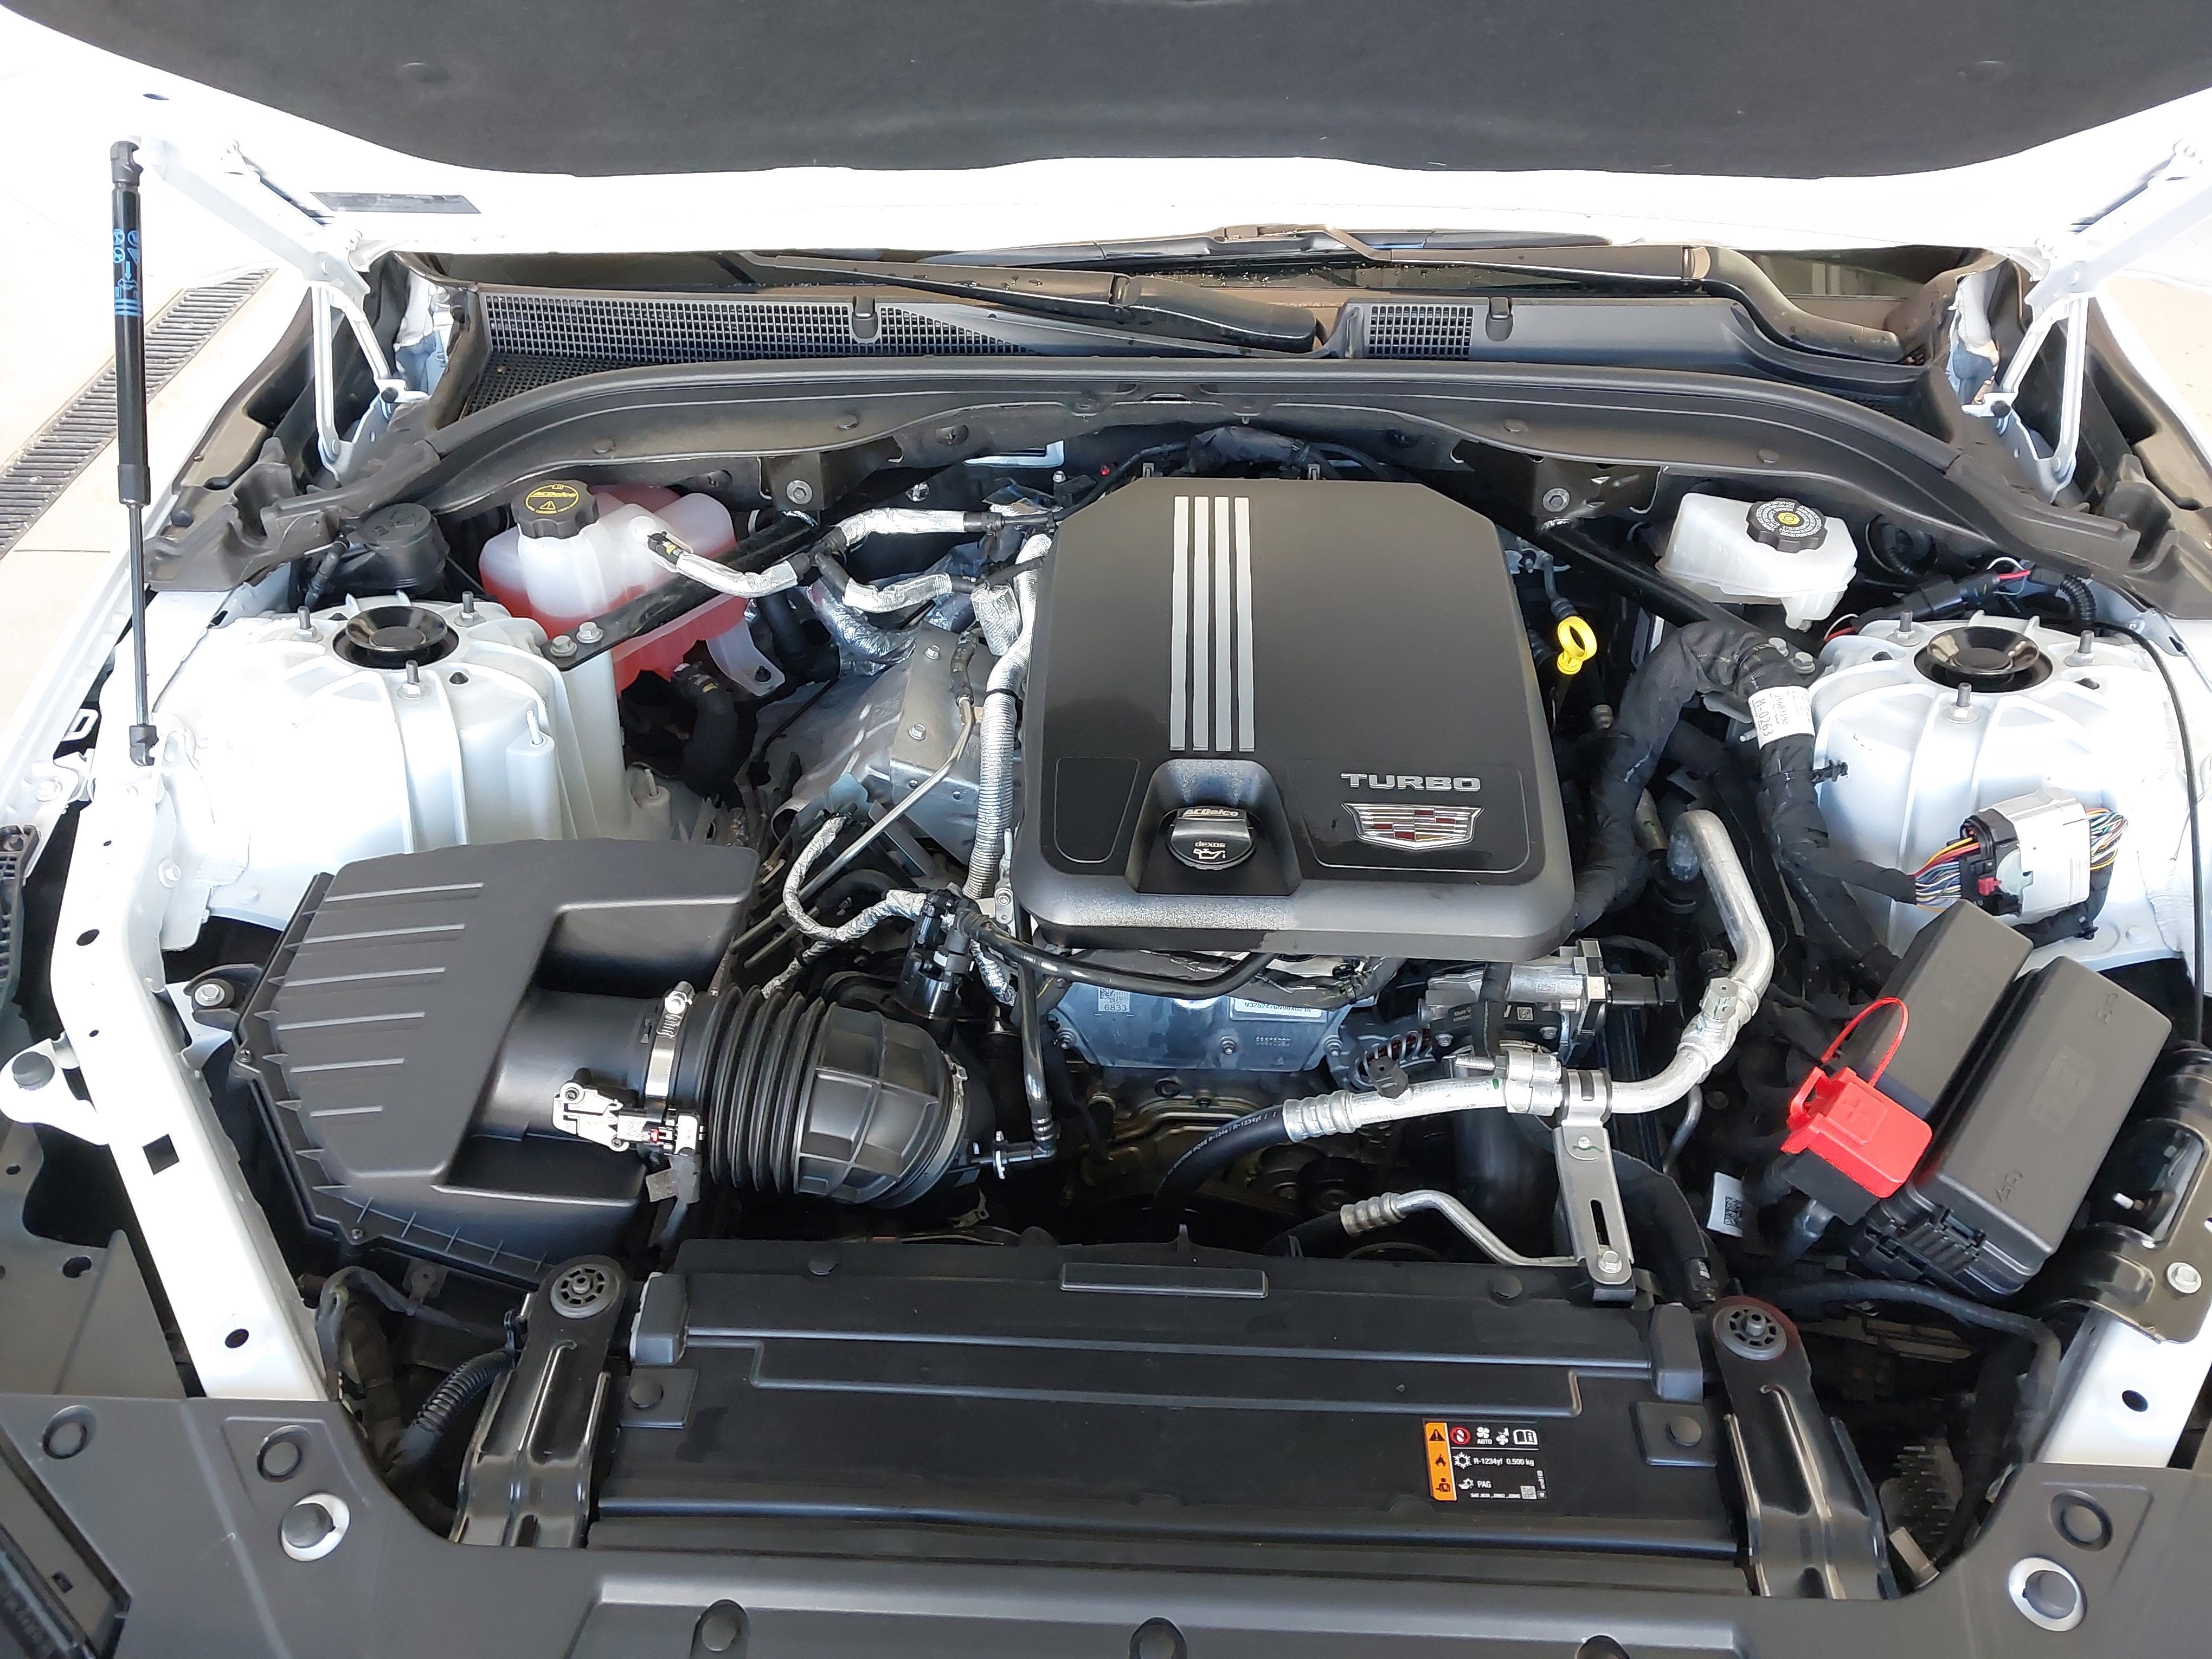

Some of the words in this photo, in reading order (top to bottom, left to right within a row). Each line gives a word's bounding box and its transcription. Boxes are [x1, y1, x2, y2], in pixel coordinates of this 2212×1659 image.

[1341, 773, 1481, 792] TURBO
[1182, 808, 1239, 816] ACDelco
[1474, 1457, 1503, 1466] R-1234yf
[1526, 1458, 1534, 1467] kg
